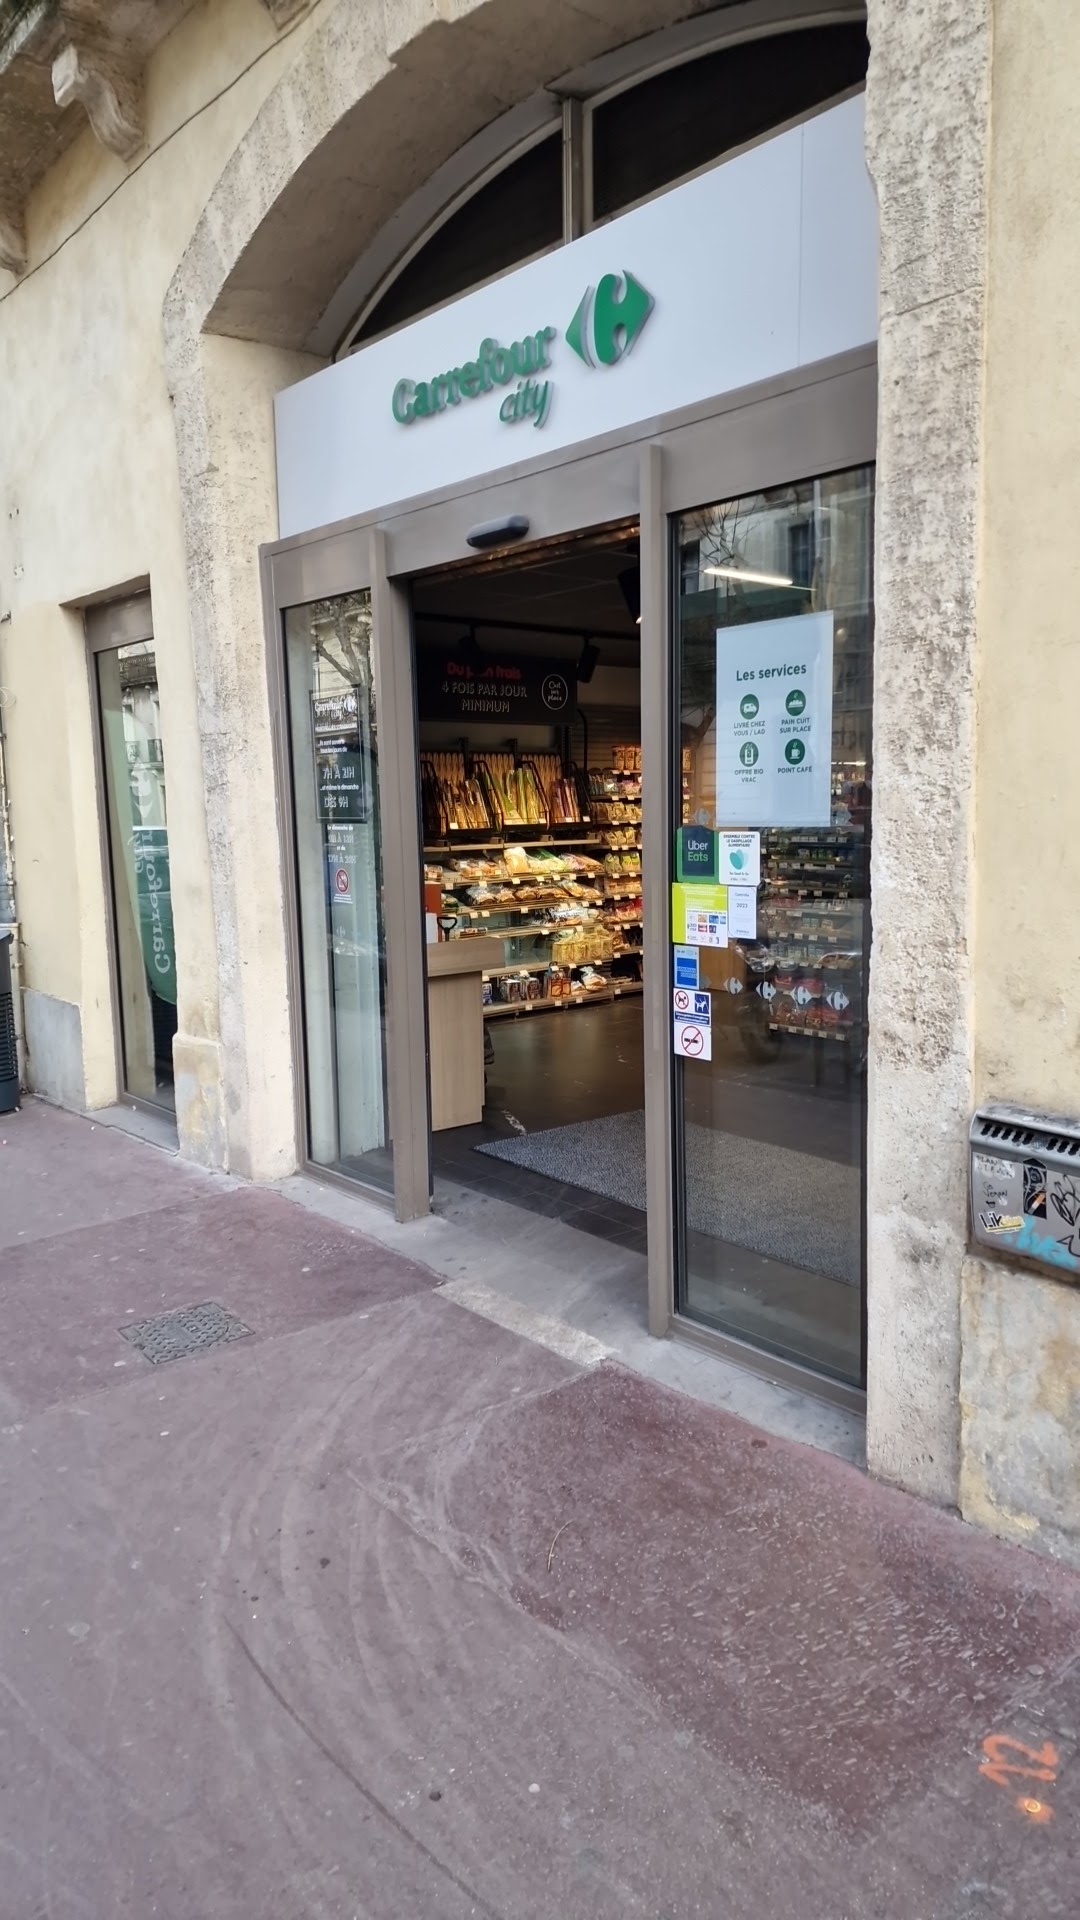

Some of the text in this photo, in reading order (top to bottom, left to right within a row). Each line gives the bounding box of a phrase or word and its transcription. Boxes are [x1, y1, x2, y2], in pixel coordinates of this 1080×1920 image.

[391, 325, 557, 424] Carrefour
[500, 379, 554, 429] city
[737, 664, 807, 681] Les services
[441, 681, 528, 697] 4 FOIS PAR JOUR
[462, 699, 510, 712] MINIMUM
[751, 720, 765, 728] CHEZ
[687, 840, 708, 851] Uber
[687, 852, 709, 862] Eats
